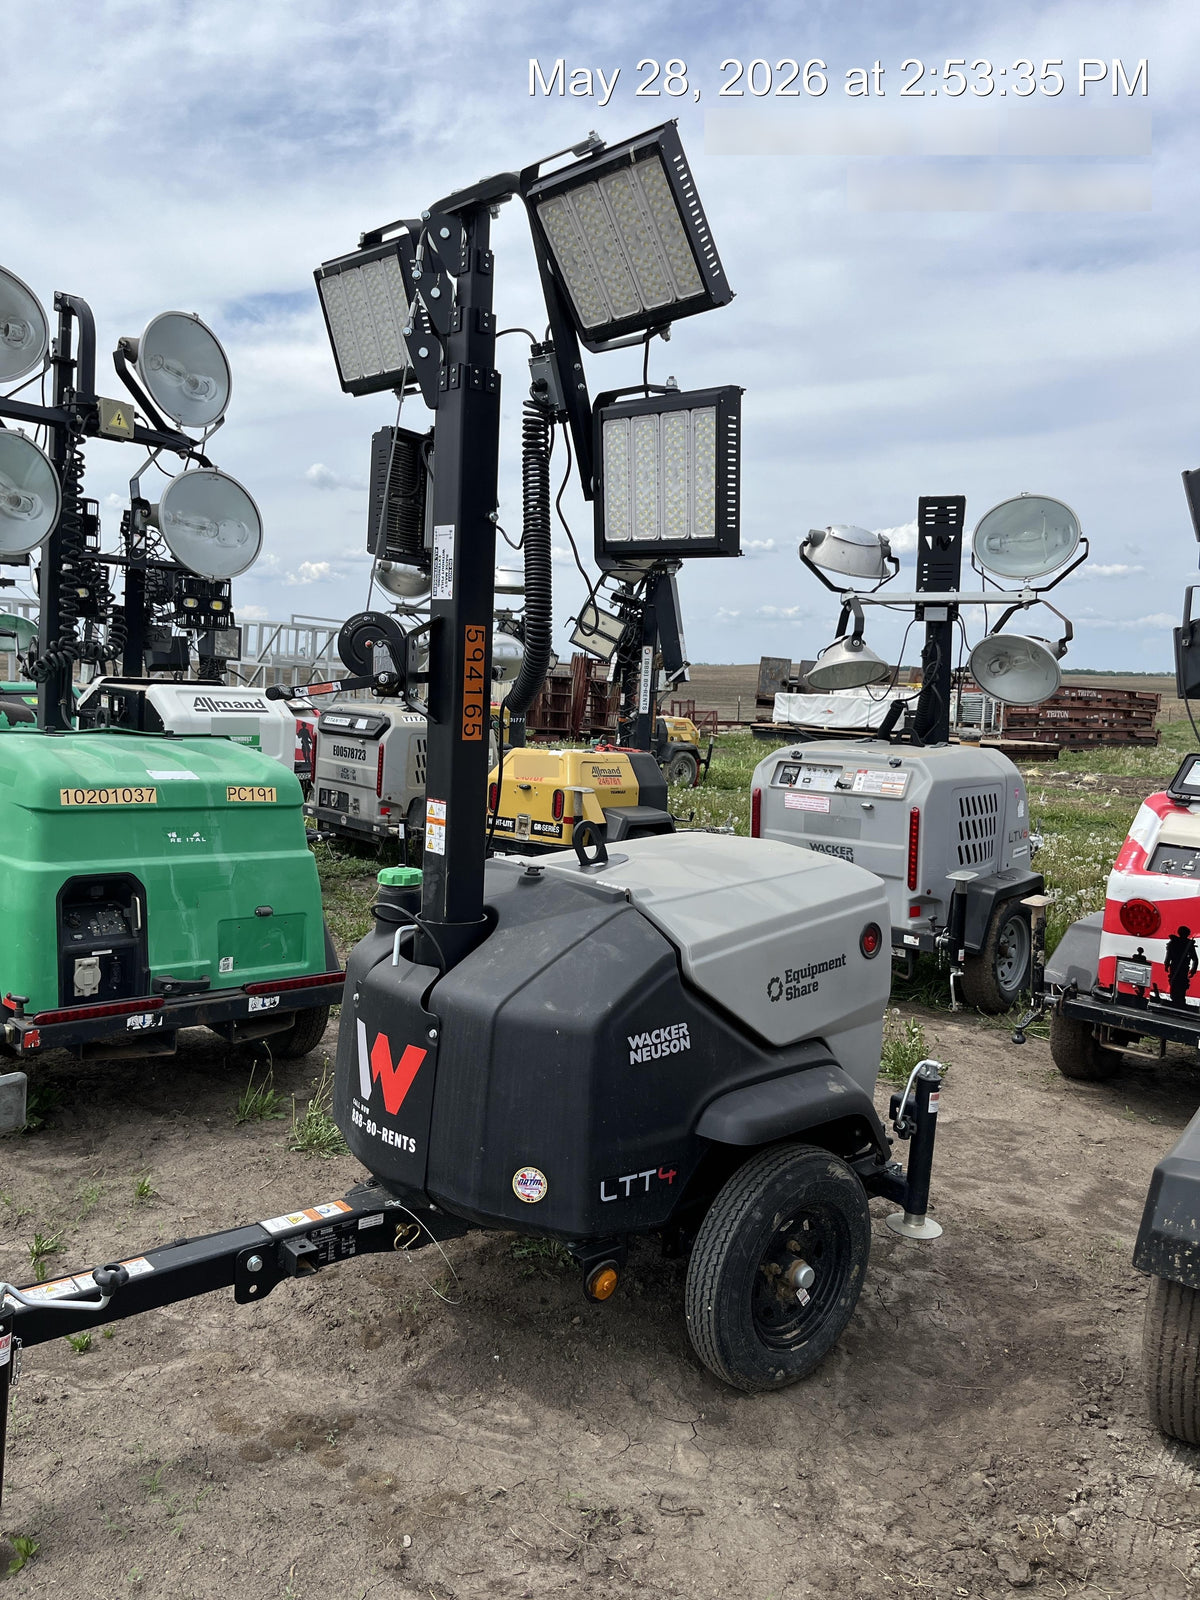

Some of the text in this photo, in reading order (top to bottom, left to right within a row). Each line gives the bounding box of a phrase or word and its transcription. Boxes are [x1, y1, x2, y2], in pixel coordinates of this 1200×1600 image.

[463, 627, 485, 737] 594165
[193, 697, 268, 713] Allmand
[1046, 710, 1069, 719] TRITON
[333, 745, 367, 761] E00578723
[591, 766, 622, 777] Allmand
[61, 788, 156, 805] 10201037
[227, 787, 275, 802] PC191
[809, 842, 854, 856] WACKER
[784, 953, 847, 984] Equipment
[785, 980, 819, 1001] Share
[627, 1022, 690, 1050] WACKER
[629, 1035, 691, 1066] NEUSON
[351, 1107, 417, 1154] 888-80-RENTS
[600, 1166, 677, 1202] LTT4
